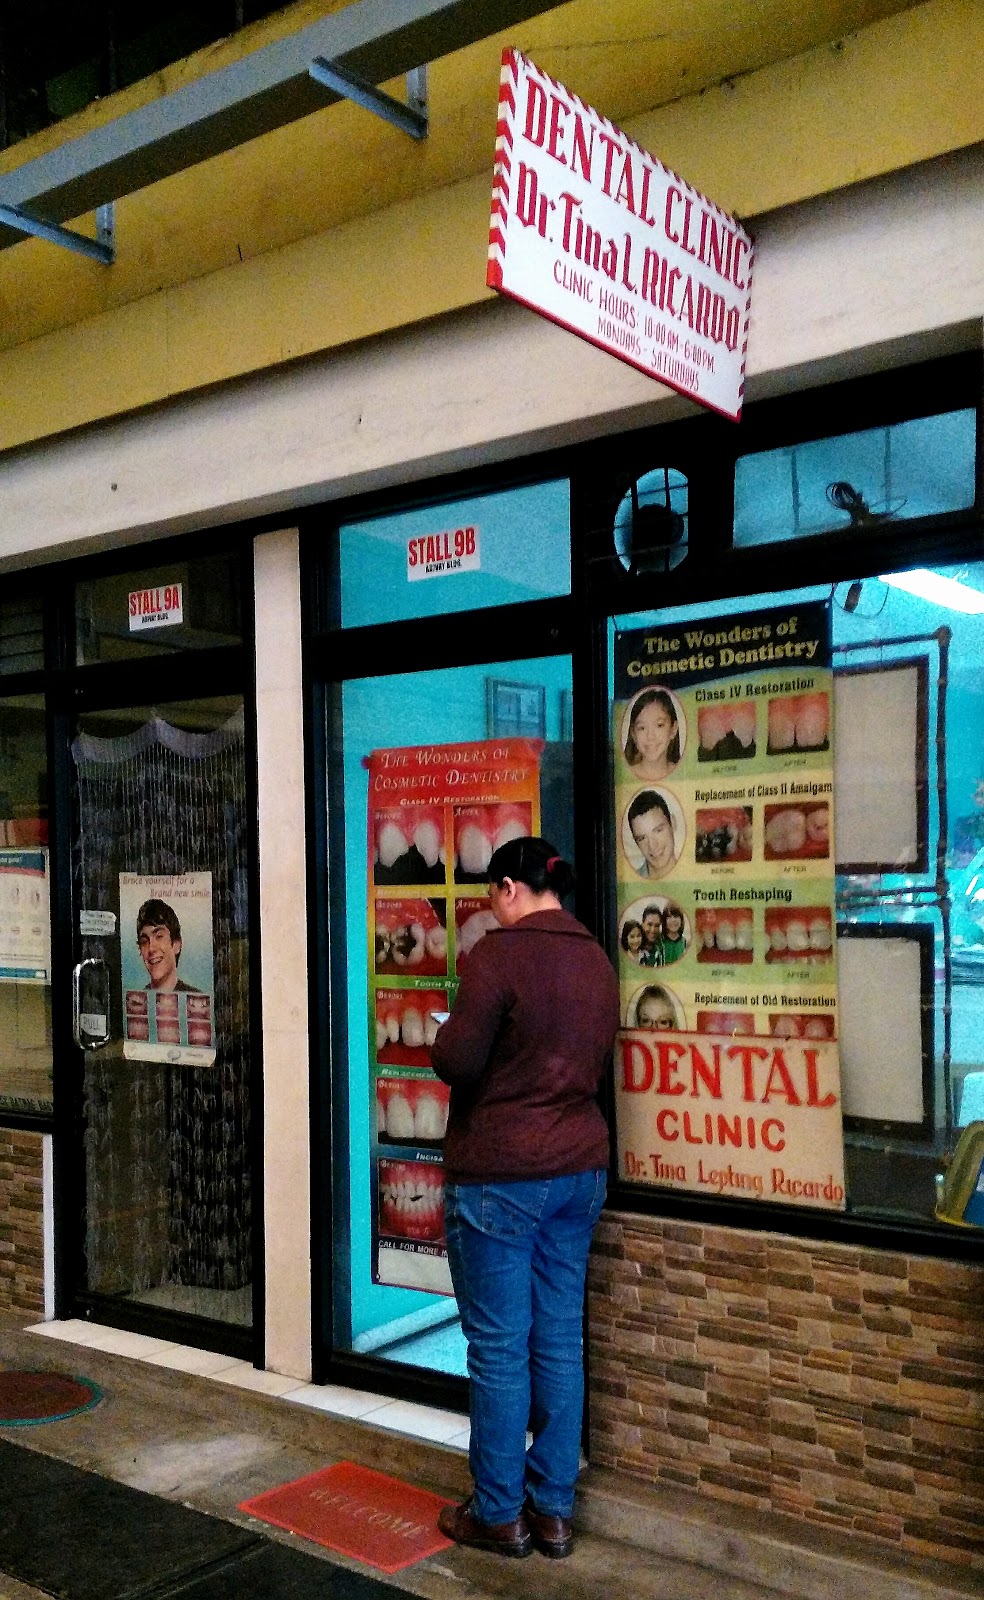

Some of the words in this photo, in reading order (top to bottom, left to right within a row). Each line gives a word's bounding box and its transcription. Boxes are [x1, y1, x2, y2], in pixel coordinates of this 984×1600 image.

[522, 74, 656, 228] DENTAL
[664, 185, 750, 291] CLINIC
[516, 160, 556, 243] Dr.
[558, 191, 618, 282] Tina
[622, 232, 638, 295] L.
[641, 246, 740, 352] RICARDO
[553, 258, 594, 304] CLINIC
[599, 286, 641, 330] HOURS:
[597, 315, 641, 356] MONDAYS
[651, 347, 699, 391] SATURDAYS
[409, 533, 452, 566] STALL
[455, 527, 476, 556] 9B
[130, 589, 162, 616] STALL
[164, 586, 179, 610] 9A
[644, 635, 680, 655] The
[684, 625, 771, 650] Wonders
[777, 616, 799, 636] of
[627, 653, 714, 678] Cosmetic
[719, 640, 819, 666] Dentistry
[695, 686, 725, 701] Class
[730, 684, 742, 698] IV
[746, 677, 815, 697] Restoration
[429, 796, 440, 804] IV
[695, 787, 746, 802] Replacement
[748, 785, 756, 796] of
[757, 783, 778, 797] Class
[790, 781, 833, 796] Amalgam
[145, 875, 174, 887] yourself
[176, 875, 187, 887] for
[783, 865, 807, 873] AFTER
[150, 888, 172, 898] Brand
[693, 888, 727, 901] Tooth
[730, 886, 793, 903] Reshaping
[787, 971, 811, 979] AFTER
[695, 992, 748, 1006] Replacement
[751, 994, 760, 1006] of
[762, 994, 778, 1006] Old
[781, 993, 836, 1007] Restoration
[620, 1038, 837, 1107] DENTAL
[656, 1109, 786, 1153] CLINIC
[624, 1151, 648, 1178] Dr.
[650, 1154, 687, 1182] Tina
[698, 1159, 764, 1198] Lepting
[772, 1168, 844, 1206] Ricardo
[378, 1239, 396, 1249] CALL
[400, 1242, 415, 1252] FOR
[417, 1245, 439, 1256] MORE
